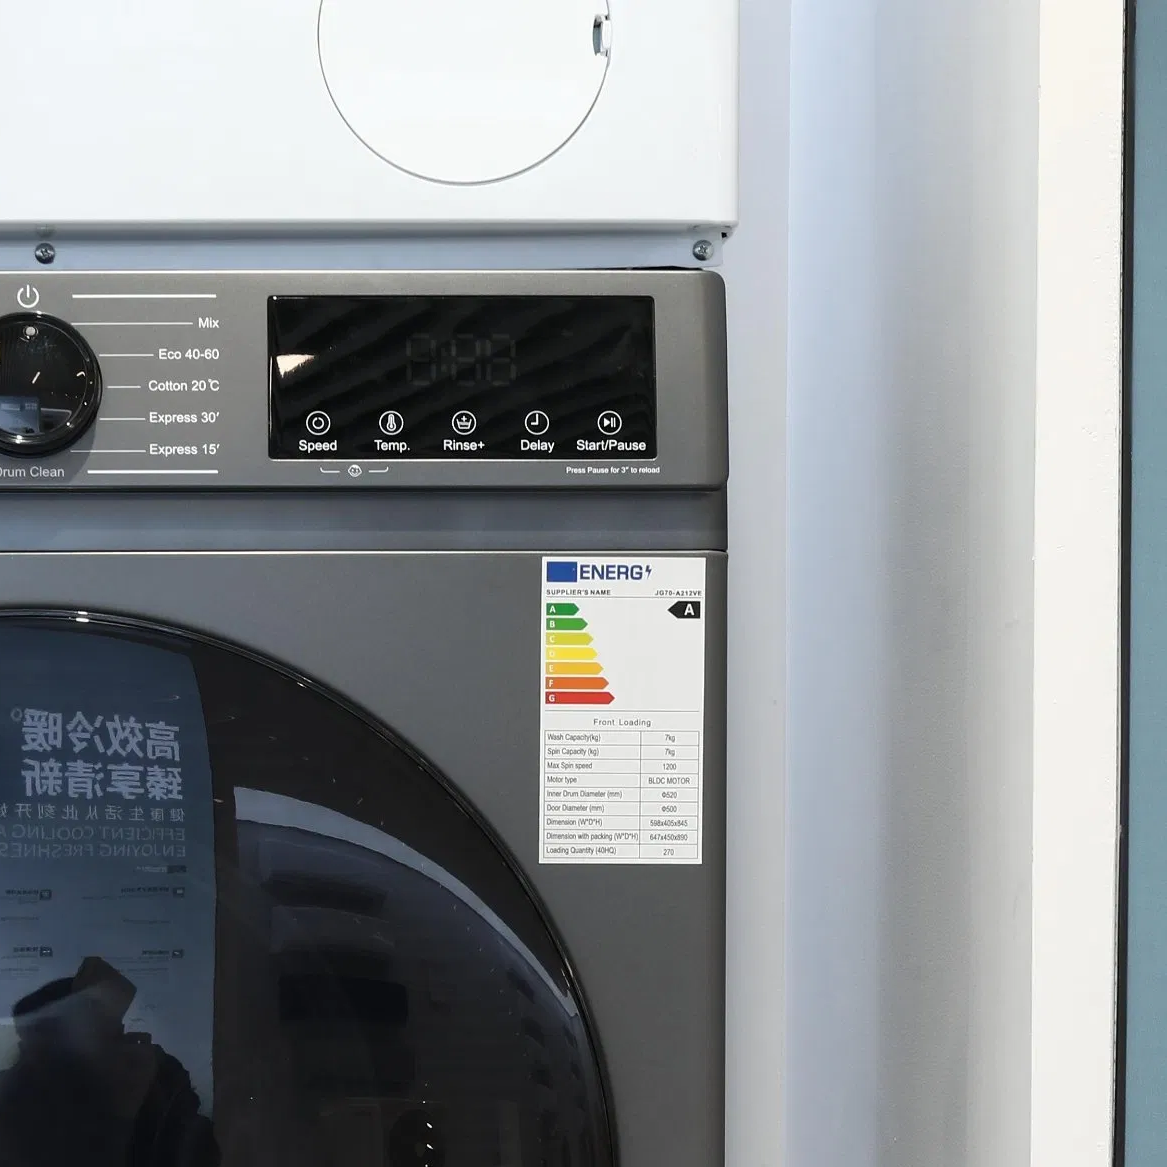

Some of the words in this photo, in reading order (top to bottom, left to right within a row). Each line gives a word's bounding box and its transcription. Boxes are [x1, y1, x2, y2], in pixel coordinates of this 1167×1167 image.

[199, 318, 219, 328] Mix
[159, 349, 181, 360] Eco
[185, 349, 220, 360] 40-60
[149, 381, 187, 391] Cotton
[150, 412, 196, 425] Express
[150, 444, 197, 457] Express
[299, 440, 337, 453] Speed
[374, 440, 410, 453] Temp.
[443, 440, 485, 451] Rinse+
[521, 440, 554, 453] Delay
[576, 439, 646, 451] Start/Pause
[30, 467, 64, 477] Clean
[580, 565, 643, 580] ENERG
[684, 604, 694, 615] A
[619, 719, 651, 727] Loading
[565, 734, 601, 742] Capacity(kg)
[562, 748, 586, 756] Capacity
[588, 748, 599, 756] (kg)
